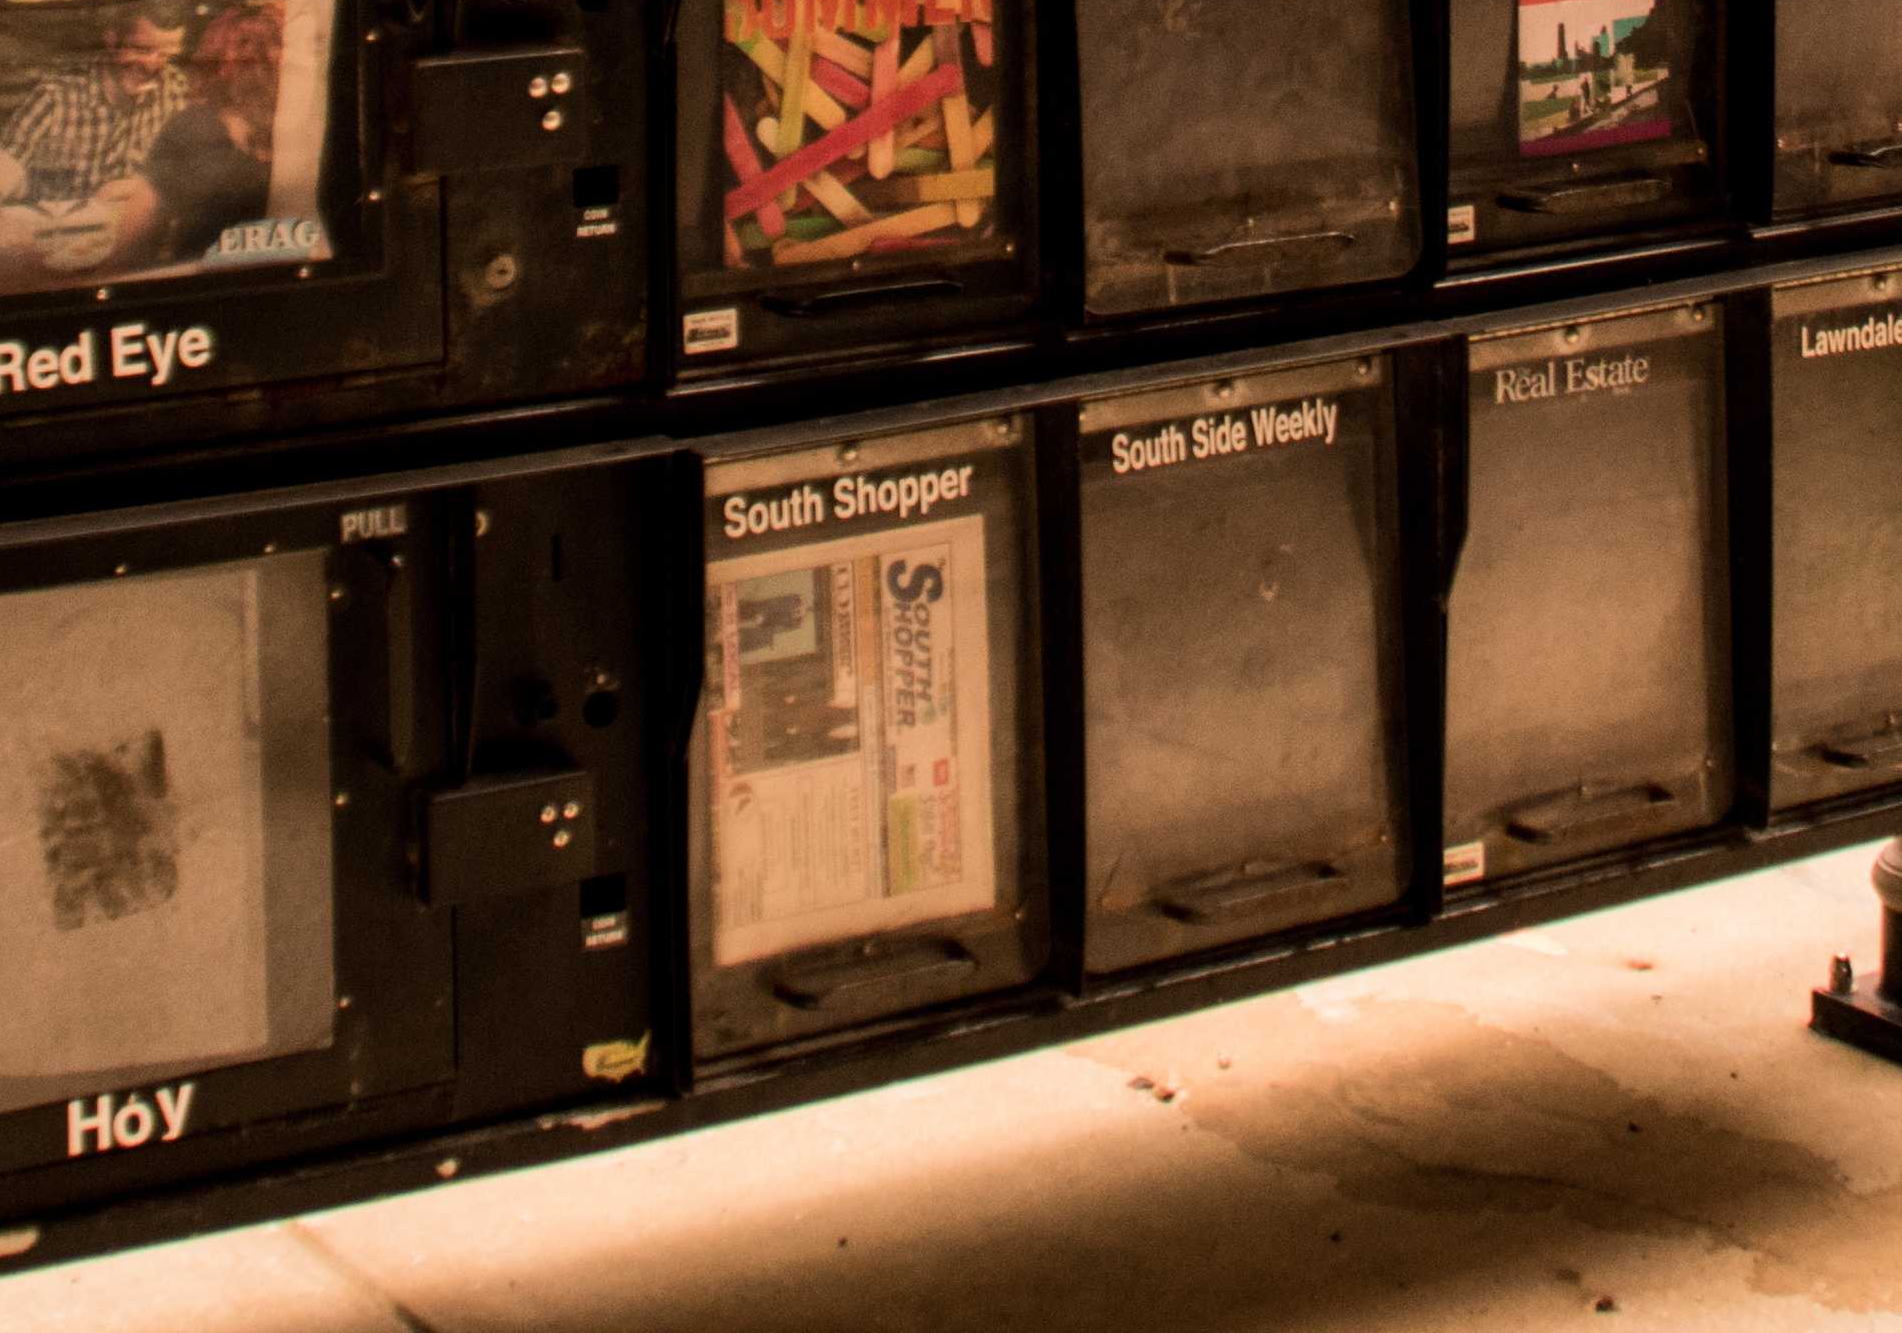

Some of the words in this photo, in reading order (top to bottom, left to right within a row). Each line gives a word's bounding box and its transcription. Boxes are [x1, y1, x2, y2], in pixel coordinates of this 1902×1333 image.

[110, 323, 213, 386] Eye
[1494, 361, 1556, 405] Real
[1564, 353, 1649, 393] Estate
[1112, 424, 1187, 474] South
[1192, 414, 1247, 459] Side
[1251, 398, 1338, 446] Weekly
[341, 506, 408, 542] PULL
[723, 485, 824, 538] South
[833, 465, 974, 519] Shopper
[66, 1081, 195, 1157] Hoy
